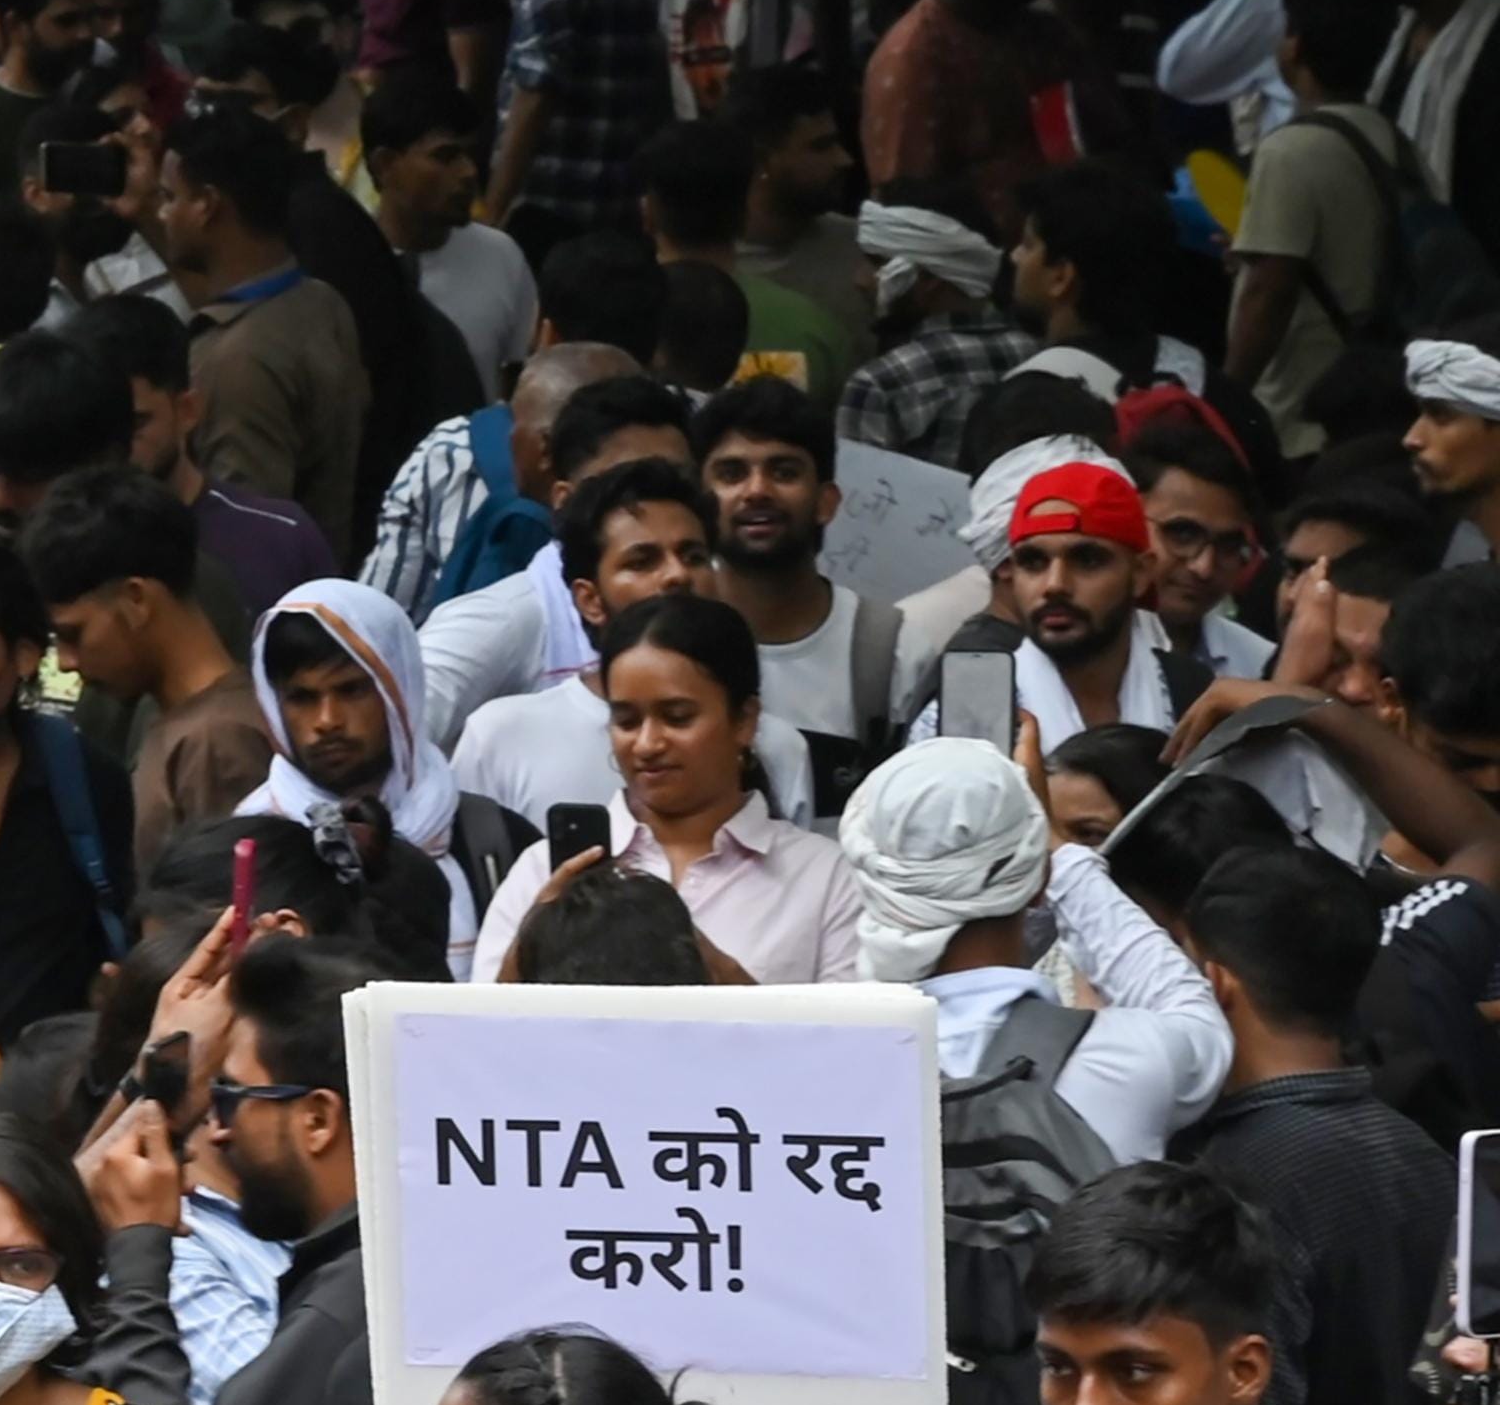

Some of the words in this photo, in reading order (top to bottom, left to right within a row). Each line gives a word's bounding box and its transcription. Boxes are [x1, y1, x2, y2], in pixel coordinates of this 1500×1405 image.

[434, 1116, 624, 1189] NTA
[648, 1107, 760, 1193] को
[782, 1133, 887, 1213] रद्द
[566, 1206, 745, 1294] करो!
